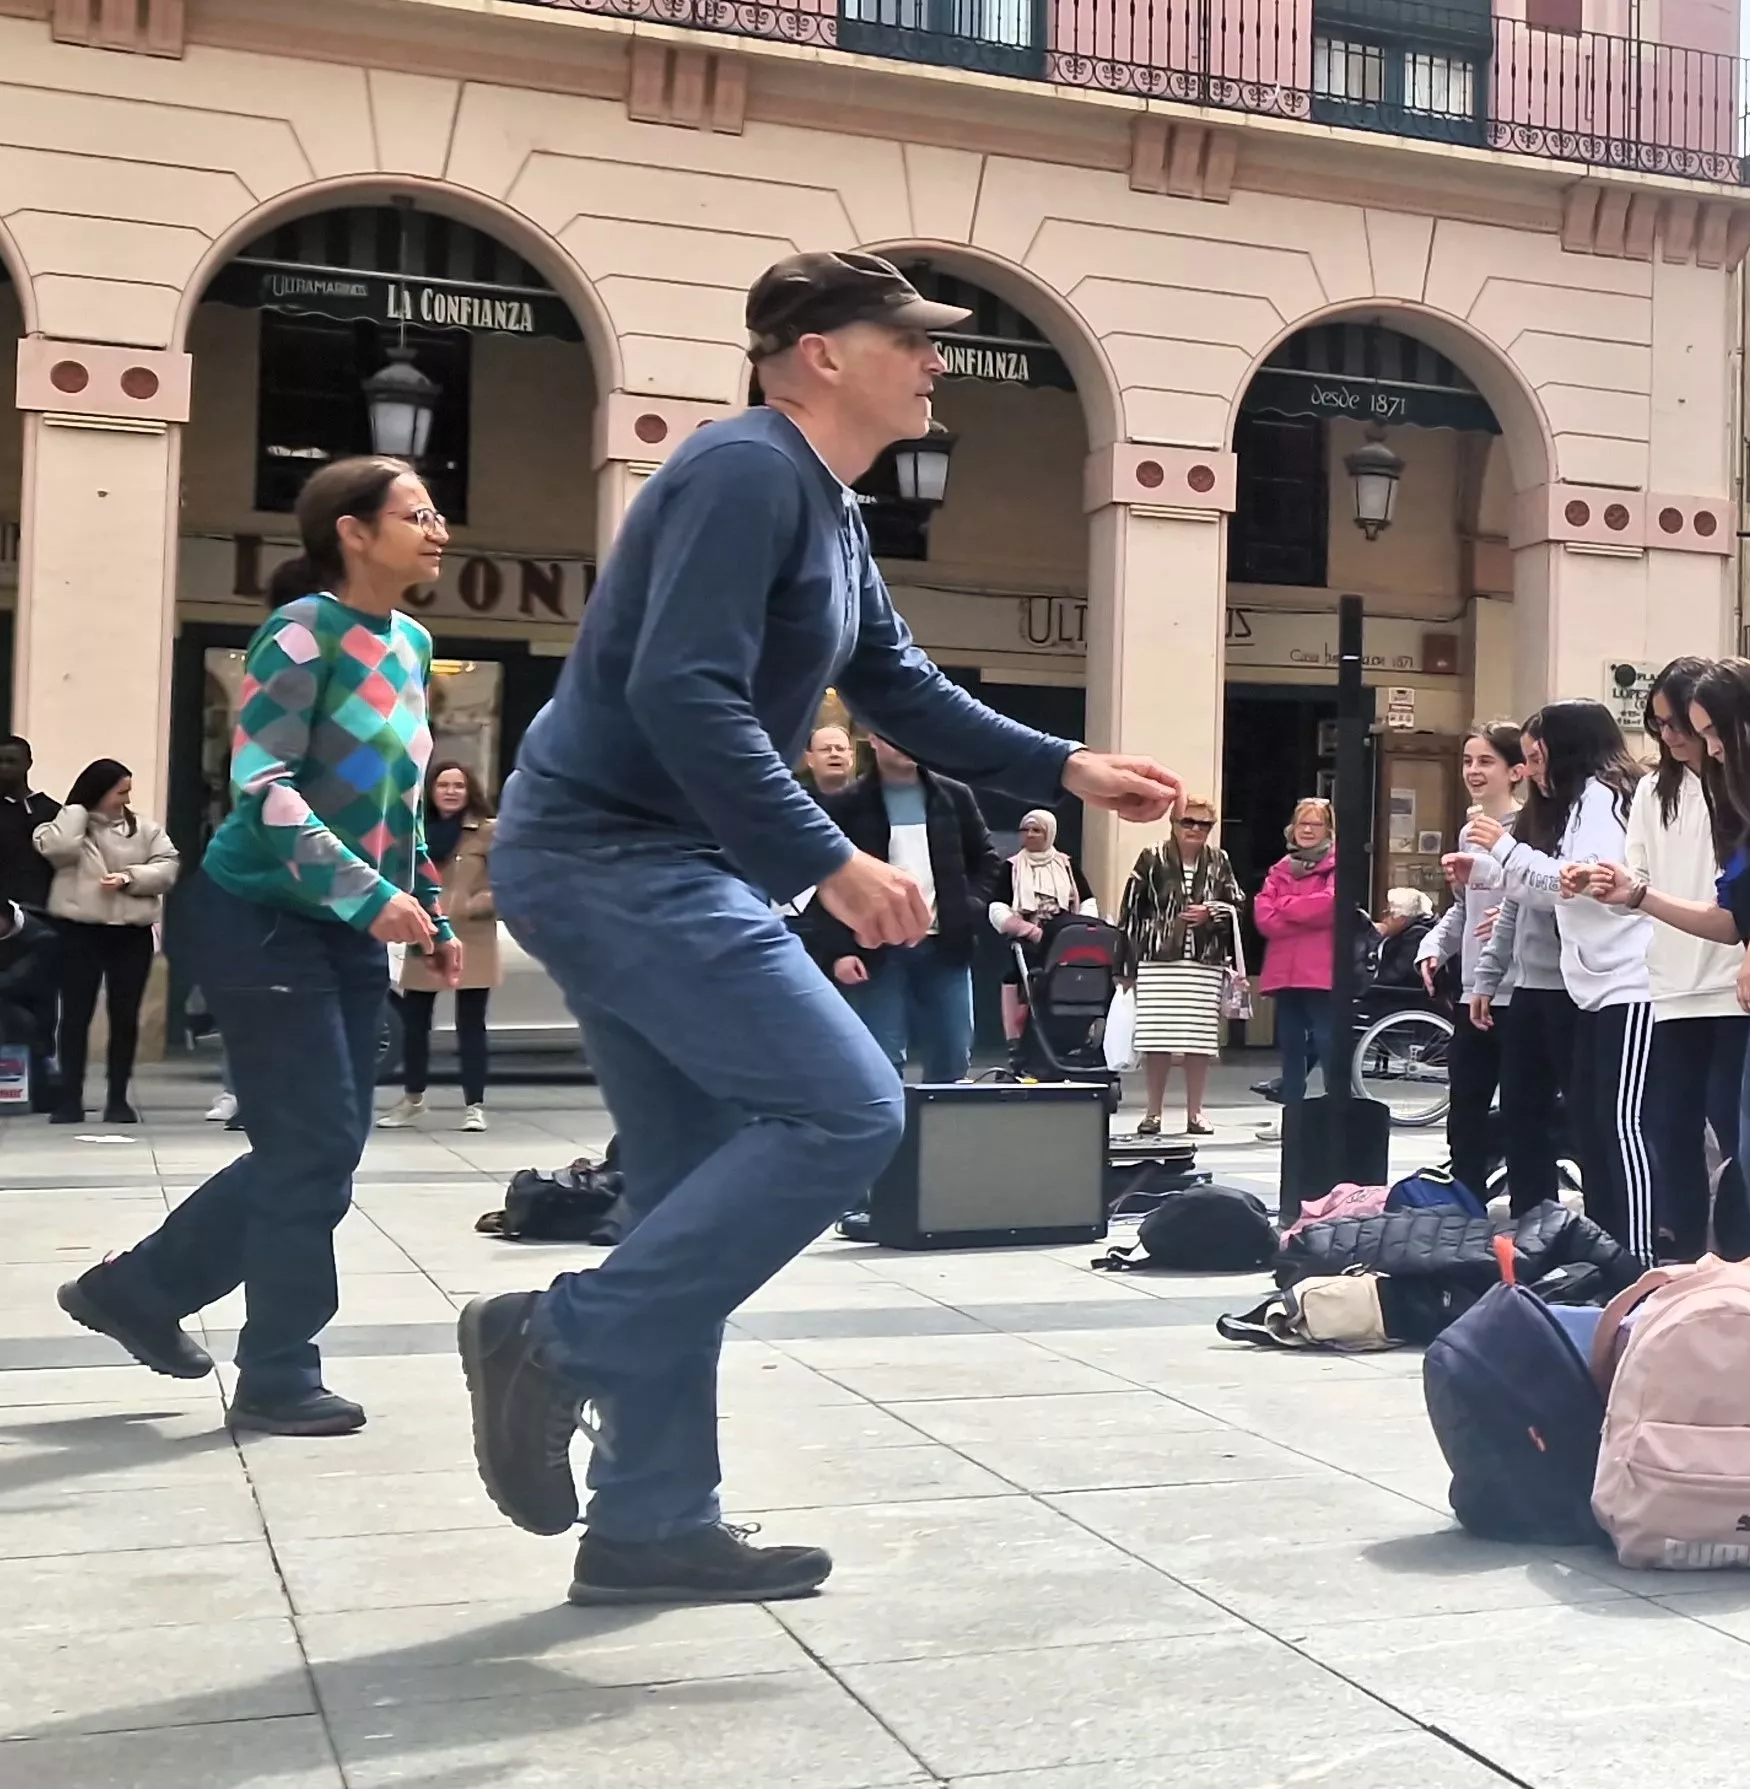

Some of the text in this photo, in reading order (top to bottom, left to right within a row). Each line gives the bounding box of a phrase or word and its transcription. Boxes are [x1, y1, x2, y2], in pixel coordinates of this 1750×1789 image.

[387, 284, 534, 332] LA CONFIANZA
[1311, 384, 1406, 418] desde 1871
